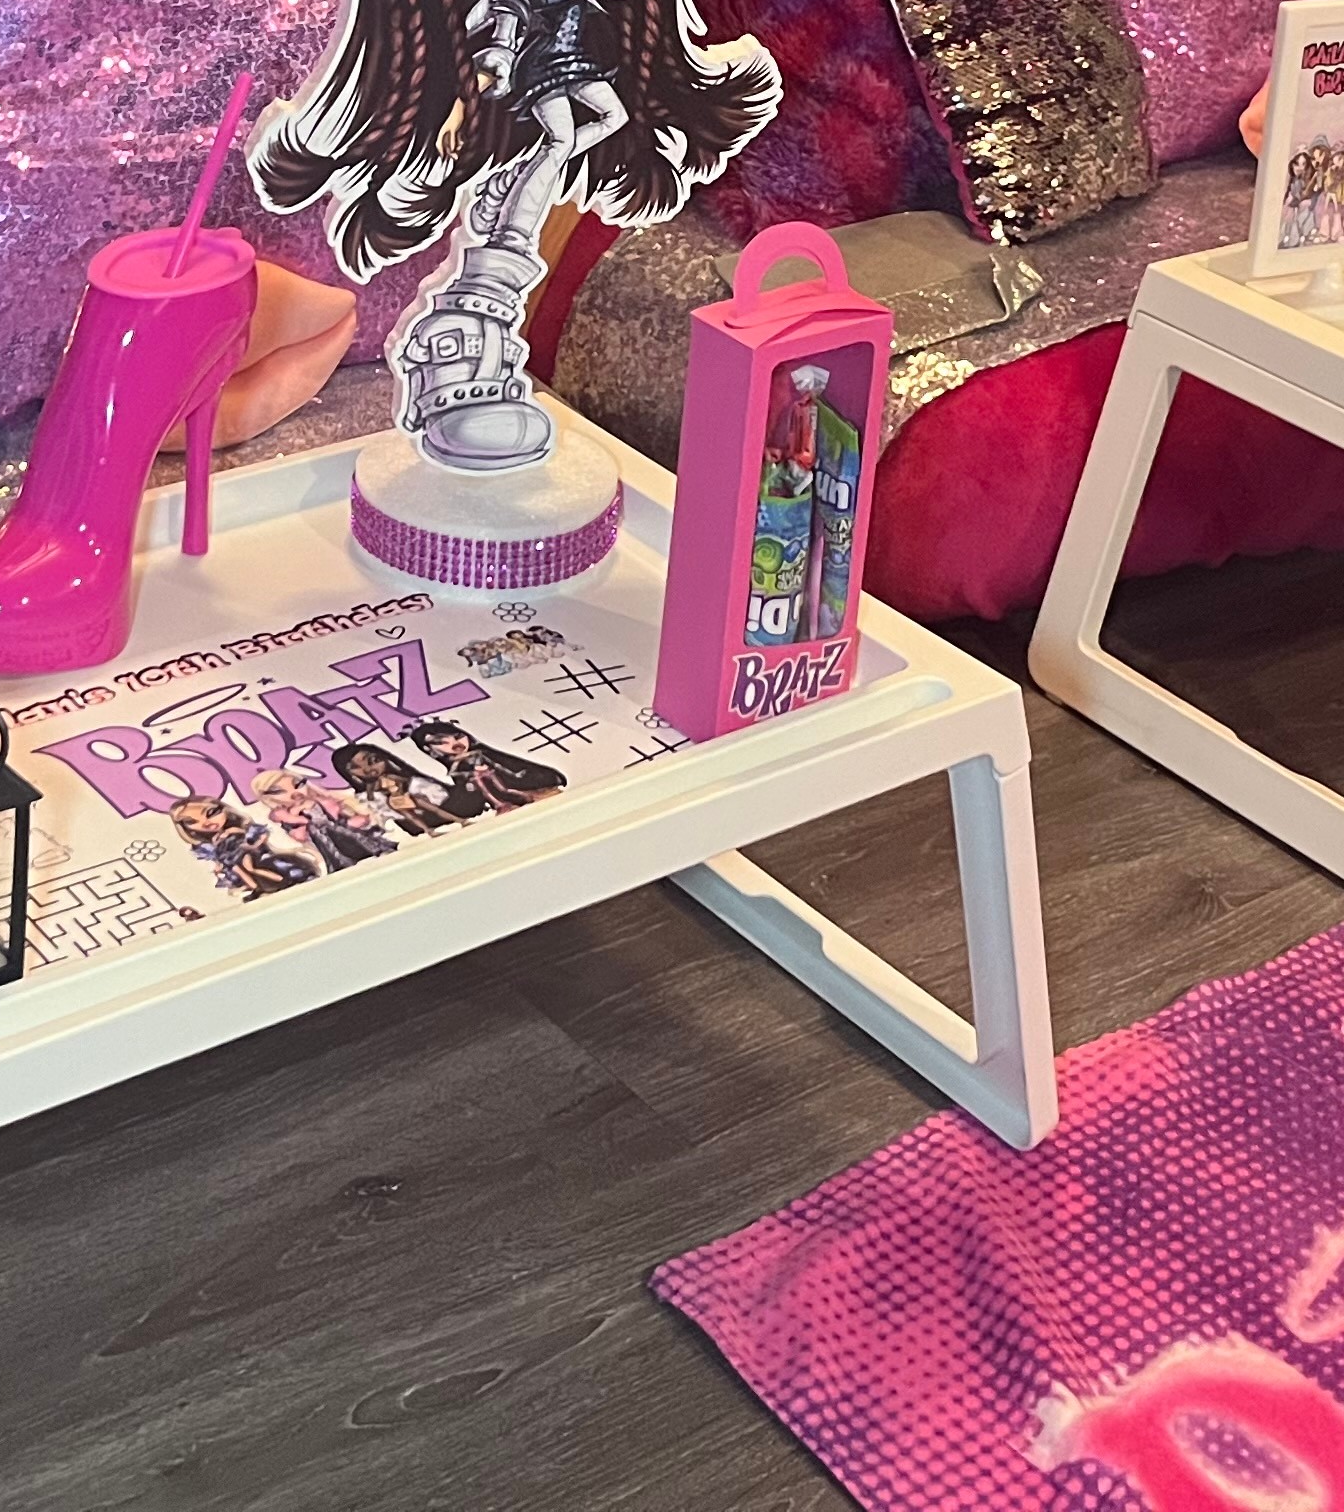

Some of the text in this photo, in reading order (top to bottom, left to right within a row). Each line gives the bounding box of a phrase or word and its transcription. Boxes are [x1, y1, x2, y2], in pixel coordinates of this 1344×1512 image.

[814, 470, 850, 510] un
[221, 593, 435, 660] Birthday
[728, 637, 852, 721] BRATZ
